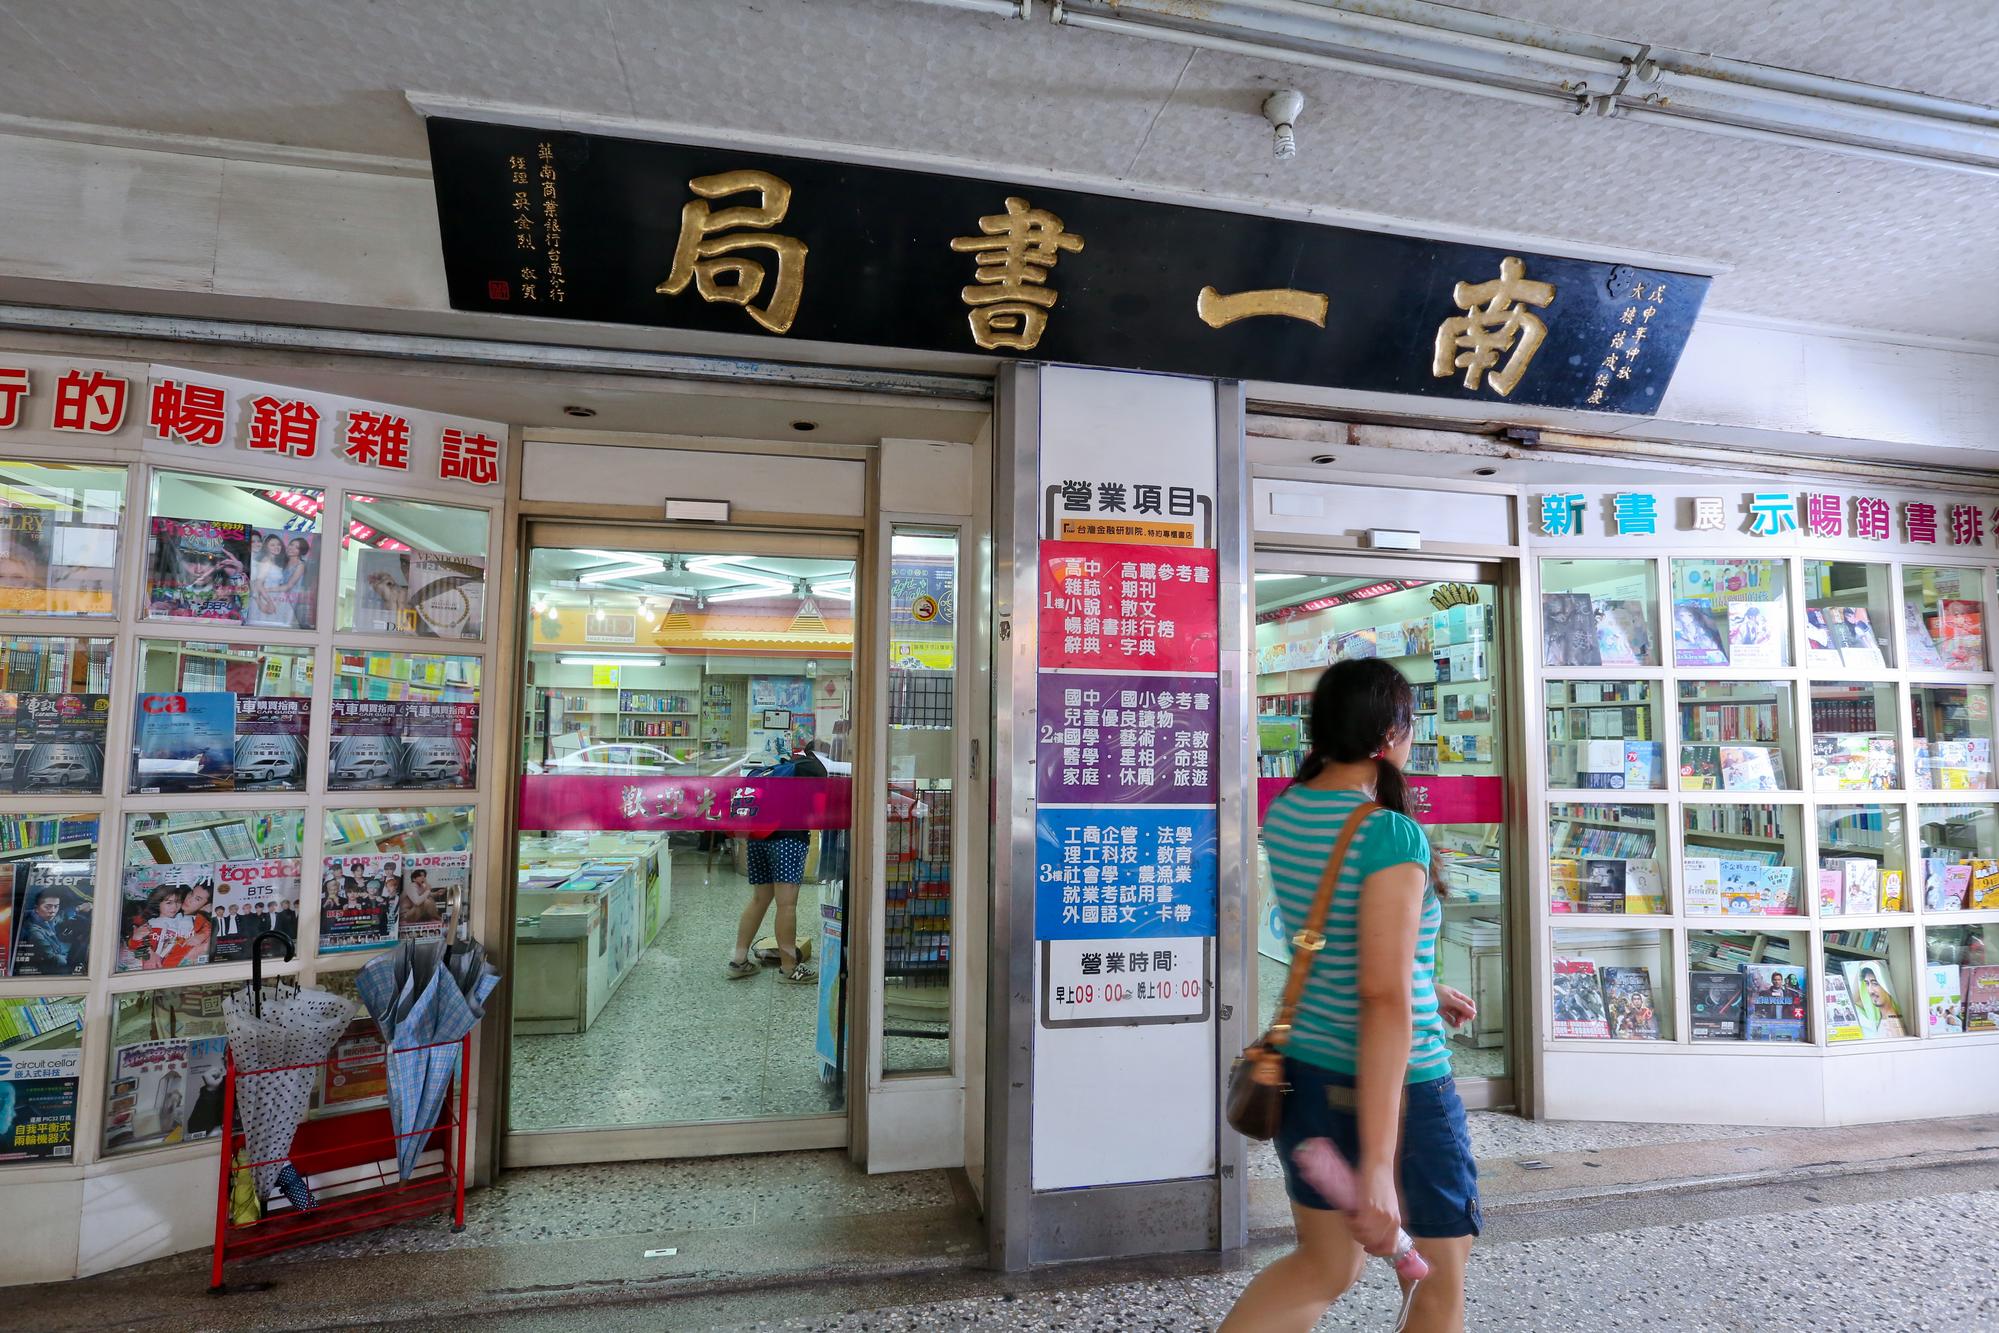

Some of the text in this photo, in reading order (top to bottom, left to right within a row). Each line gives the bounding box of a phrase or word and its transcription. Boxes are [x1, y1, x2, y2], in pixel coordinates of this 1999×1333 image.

[1061, 479, 1194, 517] 營業項目
[1541, 492, 1999, 545] 新書展示 暢銷書排
[1064, 616, 1176, 639] 暢銷書排行榜
[1063, 708, 1174, 729] 兒童優良讀物
[622, 784, 758, 821] 歡迎光臨
[219, 864, 260, 886] top
[248, 885, 274, 897] BTS
[1062, 885, 1174, 905] 就業考試用書
[15, 1058, 77, 1070] circuit cellar
